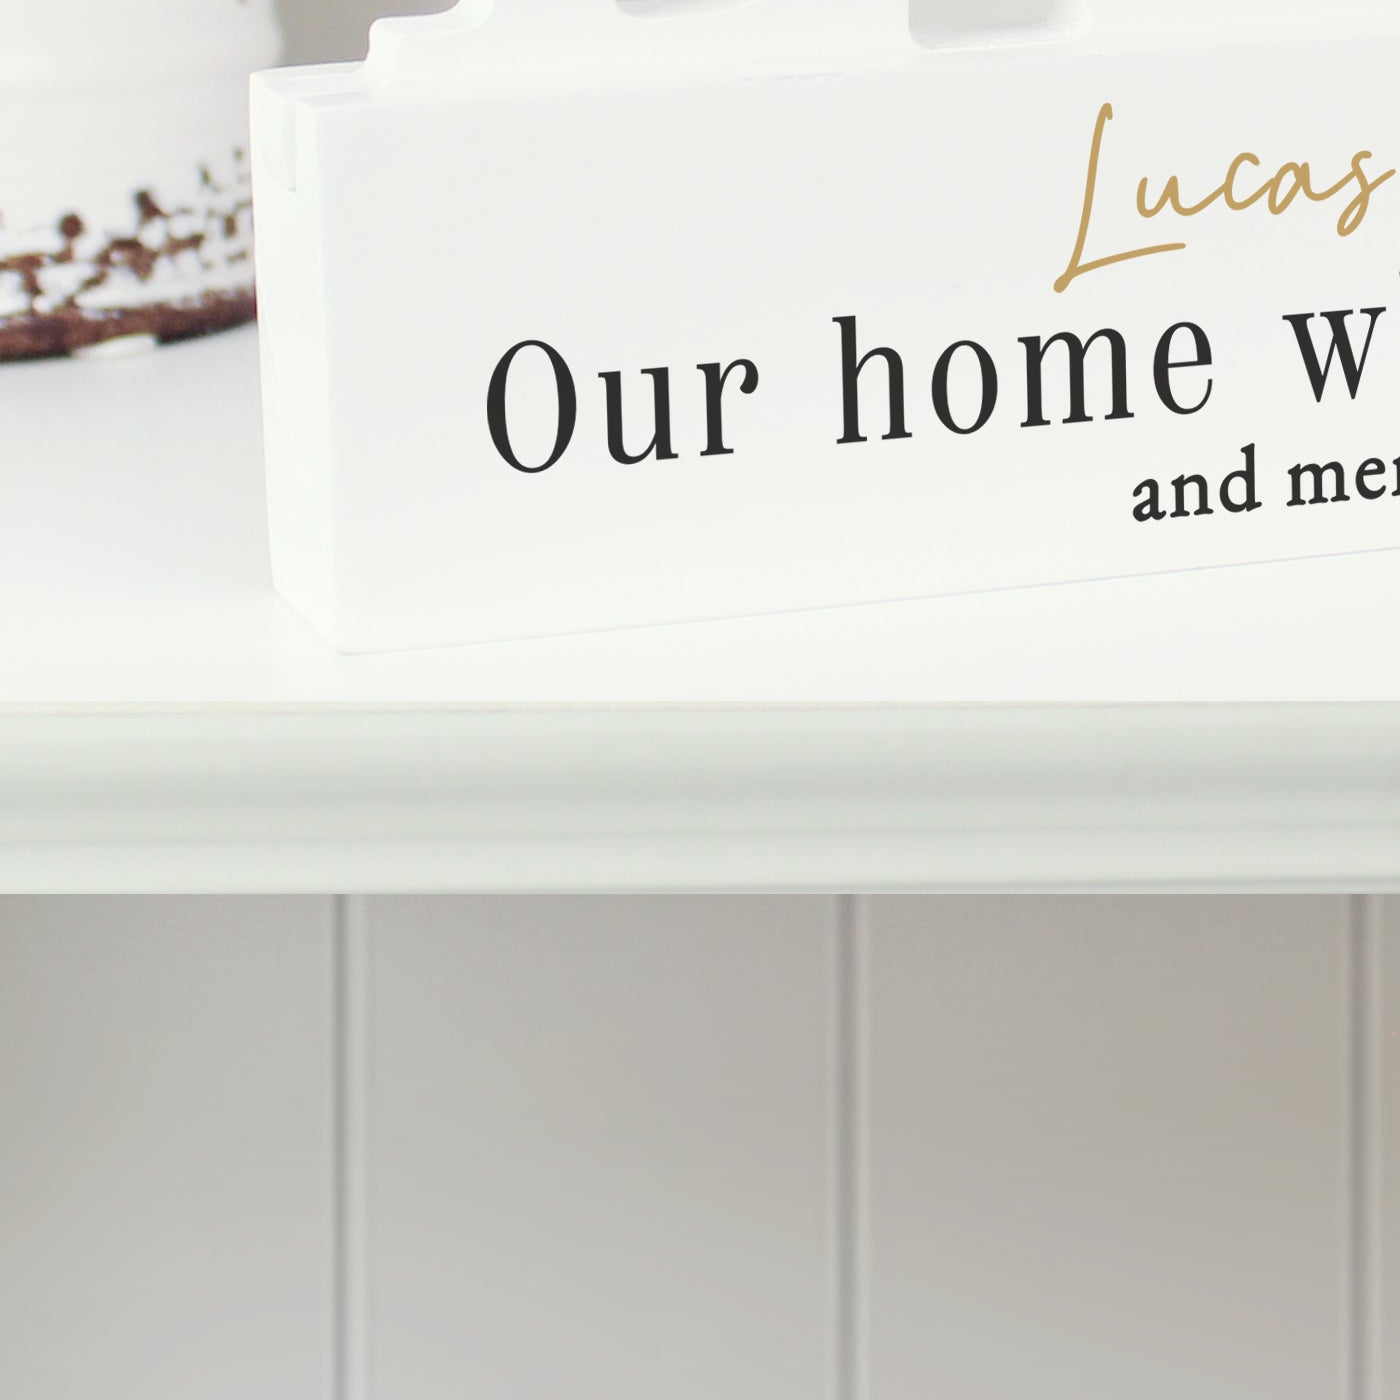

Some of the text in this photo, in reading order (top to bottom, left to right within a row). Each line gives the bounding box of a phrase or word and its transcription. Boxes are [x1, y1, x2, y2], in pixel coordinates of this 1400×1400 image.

[1053, 102, 1396, 293] Lucas
[486, 339, 759, 474] Our
[831, 315, 1213, 445] home
[1132, 442, 1263, 523] and
